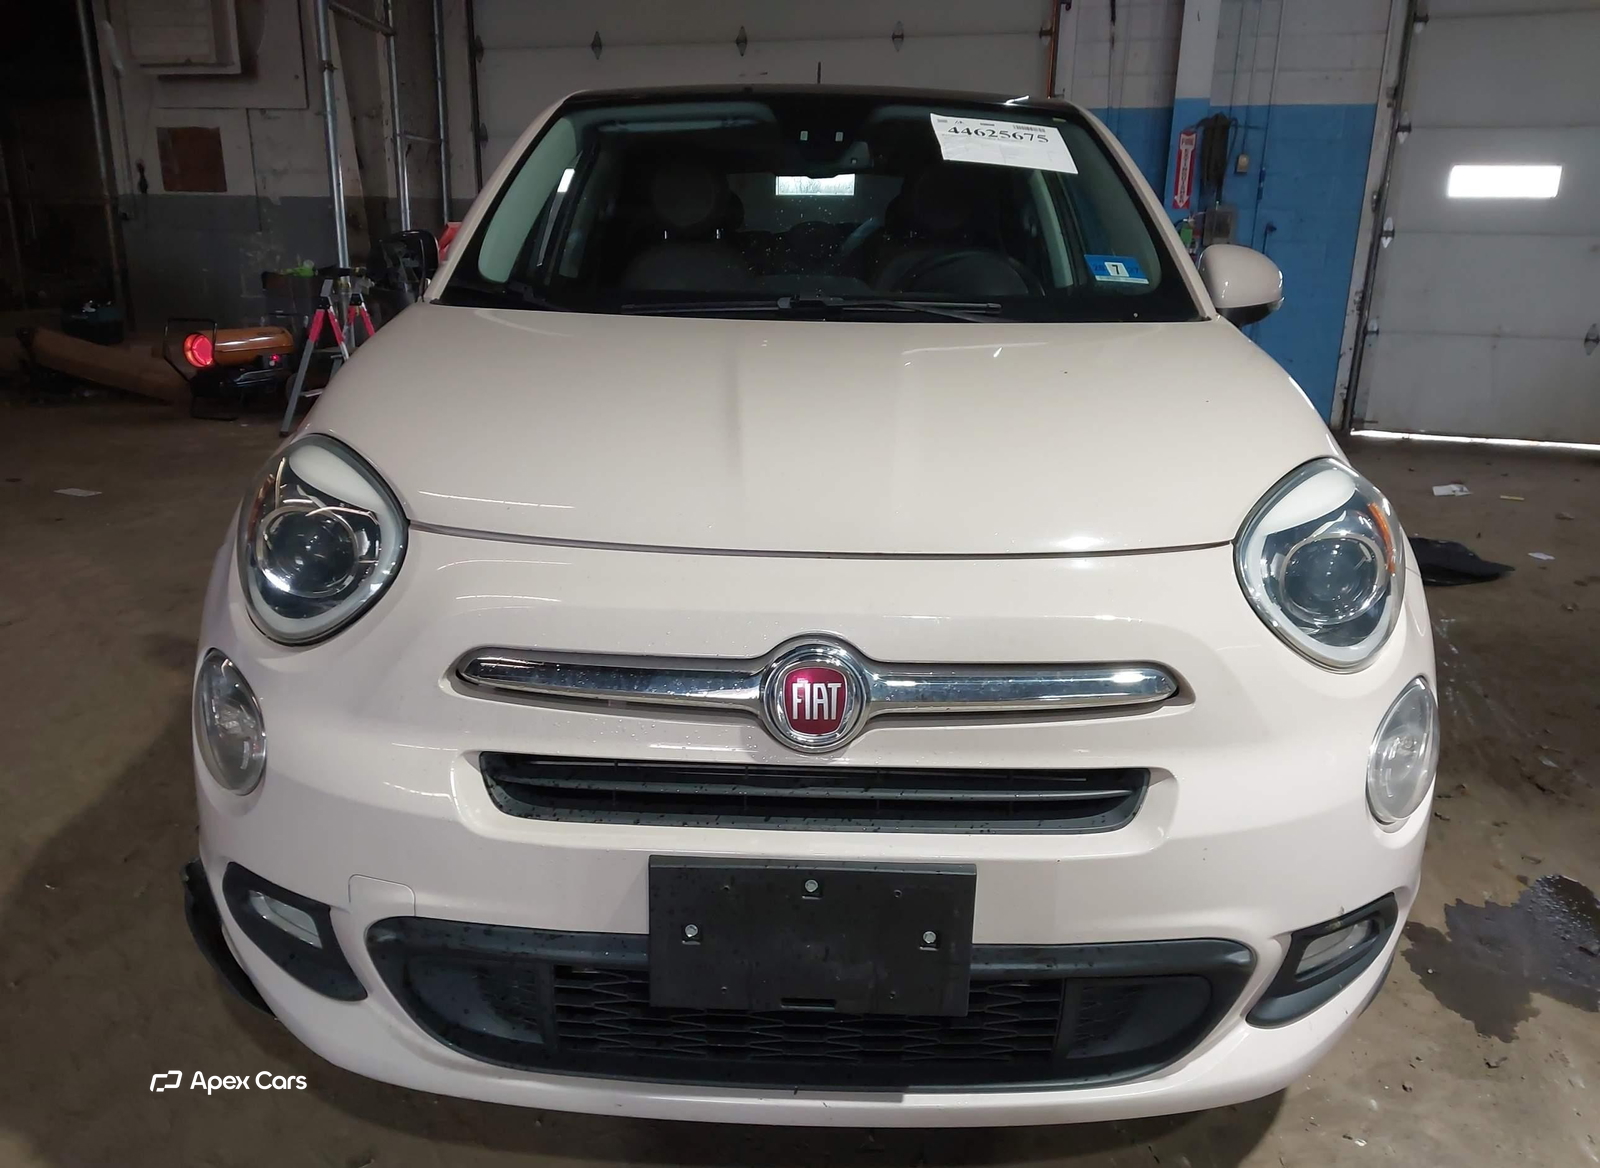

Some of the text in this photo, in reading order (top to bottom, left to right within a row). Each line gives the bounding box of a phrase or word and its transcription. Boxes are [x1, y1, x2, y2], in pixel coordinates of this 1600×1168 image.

[948, 126, 1049, 143] 44625675
[1111, 264, 1120, 275] 7
[792, 682, 842, 720] FIAT
